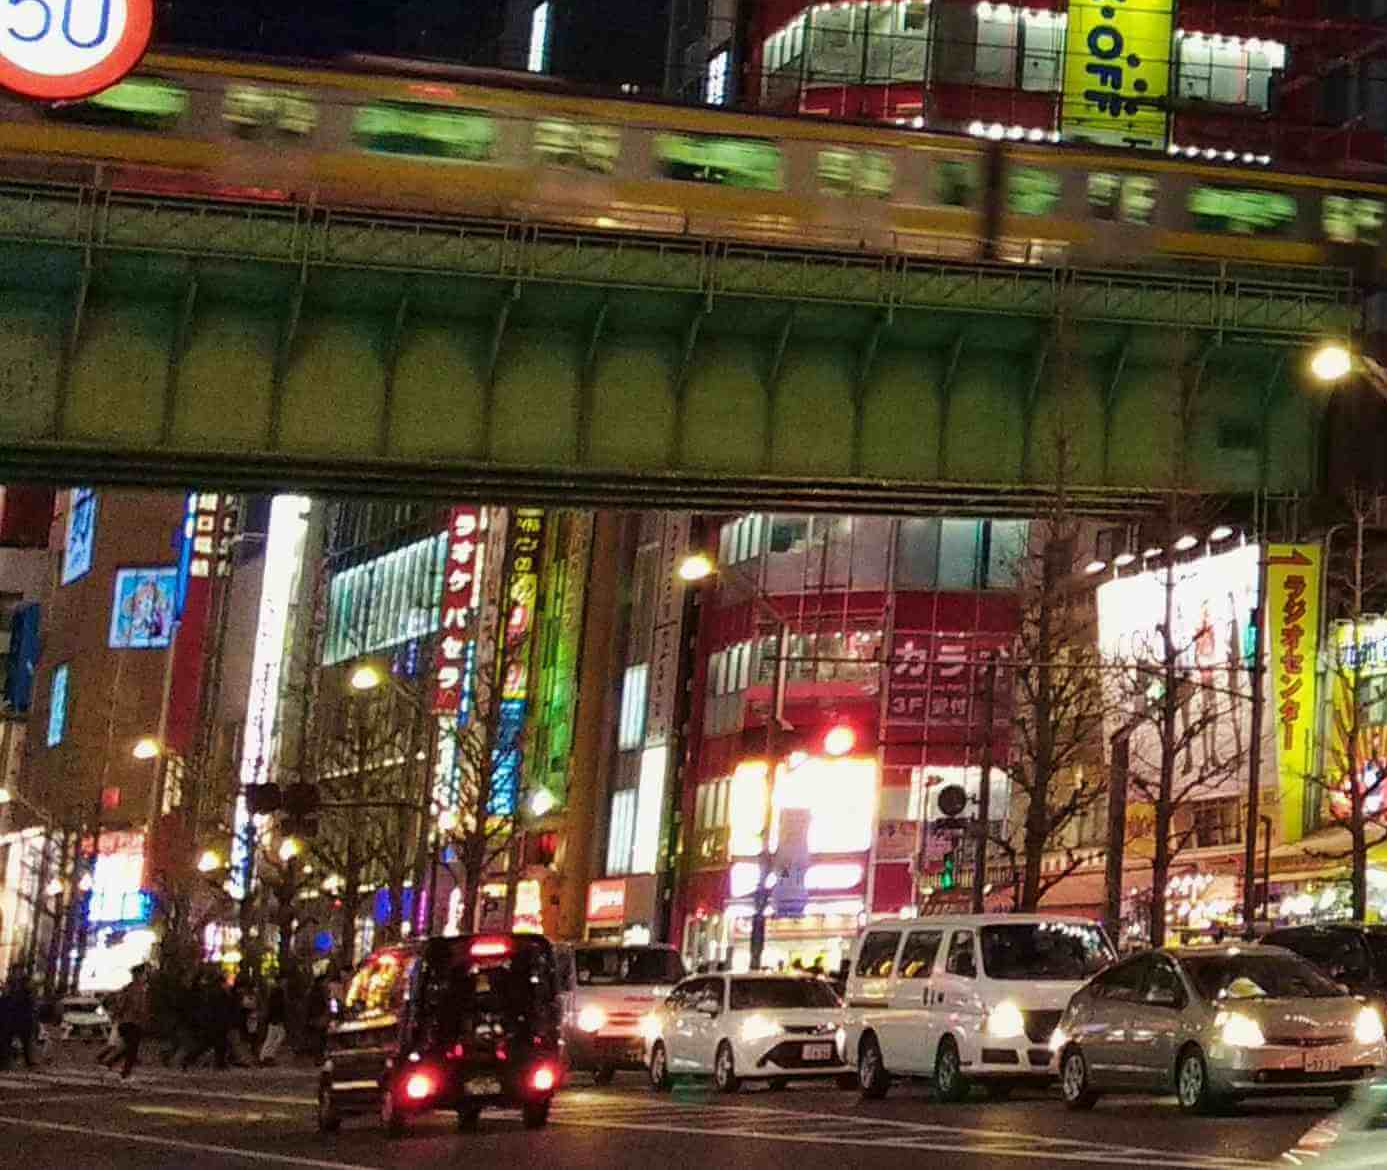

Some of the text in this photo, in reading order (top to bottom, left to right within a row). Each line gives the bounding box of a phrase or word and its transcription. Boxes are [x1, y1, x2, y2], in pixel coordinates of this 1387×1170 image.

[1279, 573, 1308, 751] ラジオセンター
